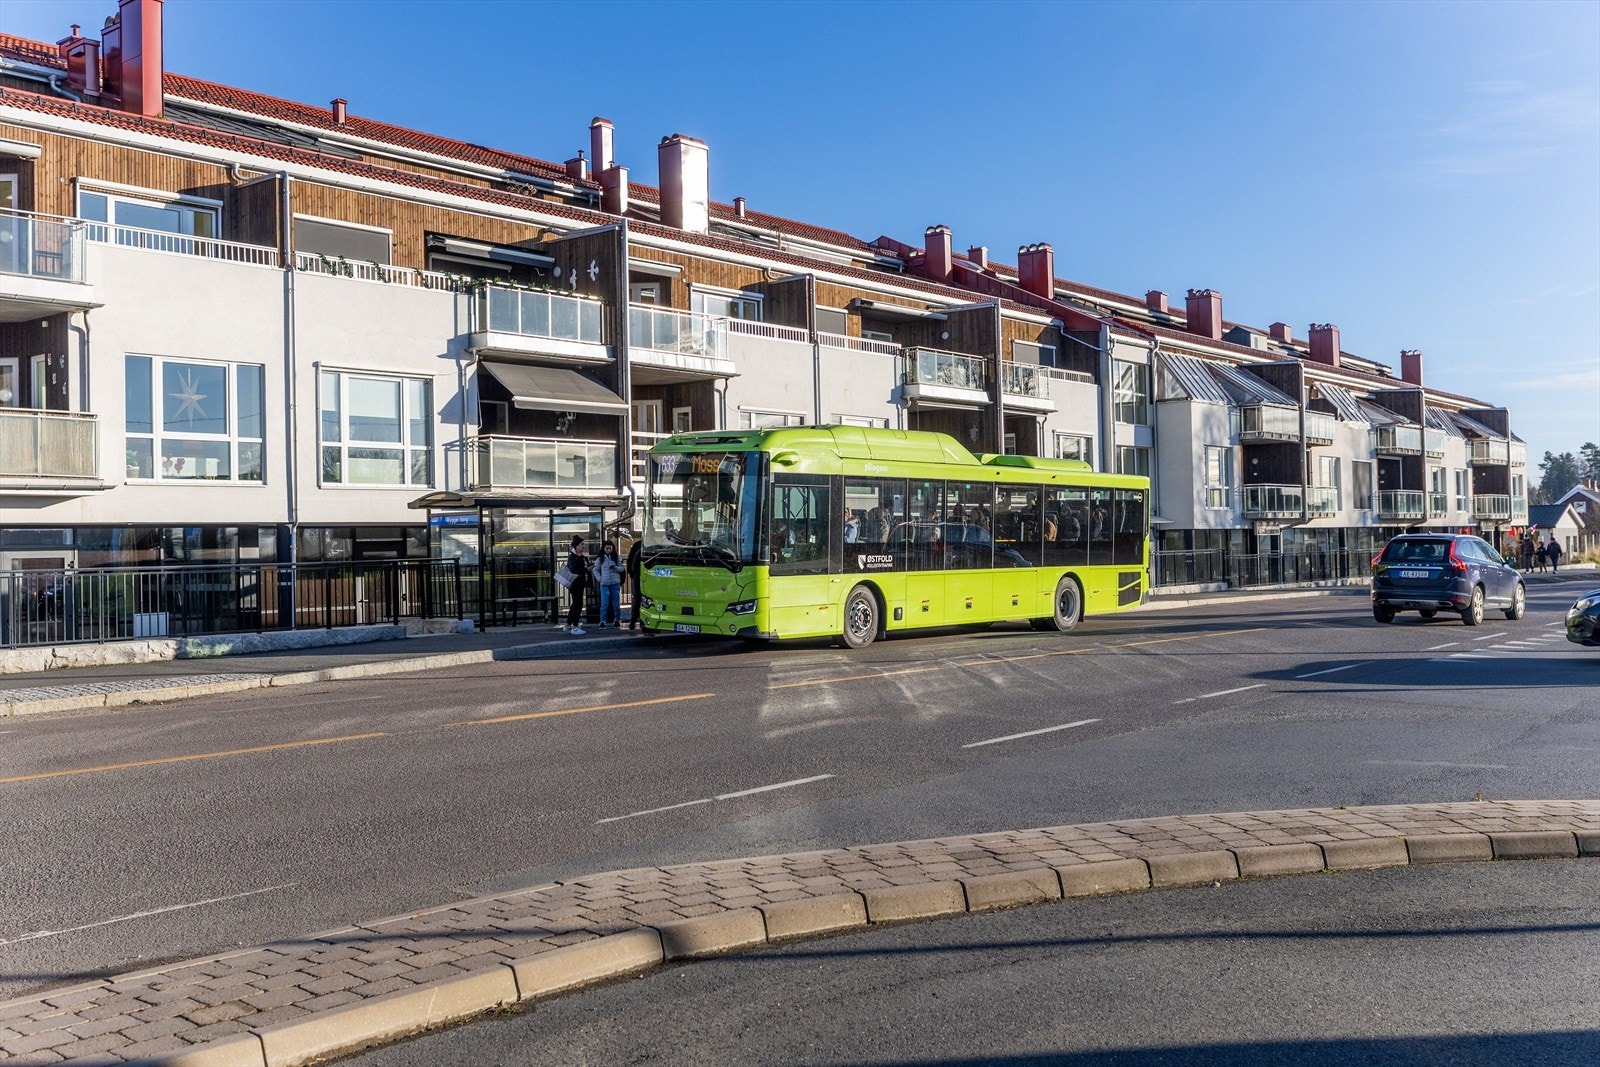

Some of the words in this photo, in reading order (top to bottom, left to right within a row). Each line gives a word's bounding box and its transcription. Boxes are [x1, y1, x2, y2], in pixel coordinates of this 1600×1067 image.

[662, 455, 675, 473] 633
[692, 454, 720, 473] Moss
[867, 554, 892, 563] ØSTFOLD
